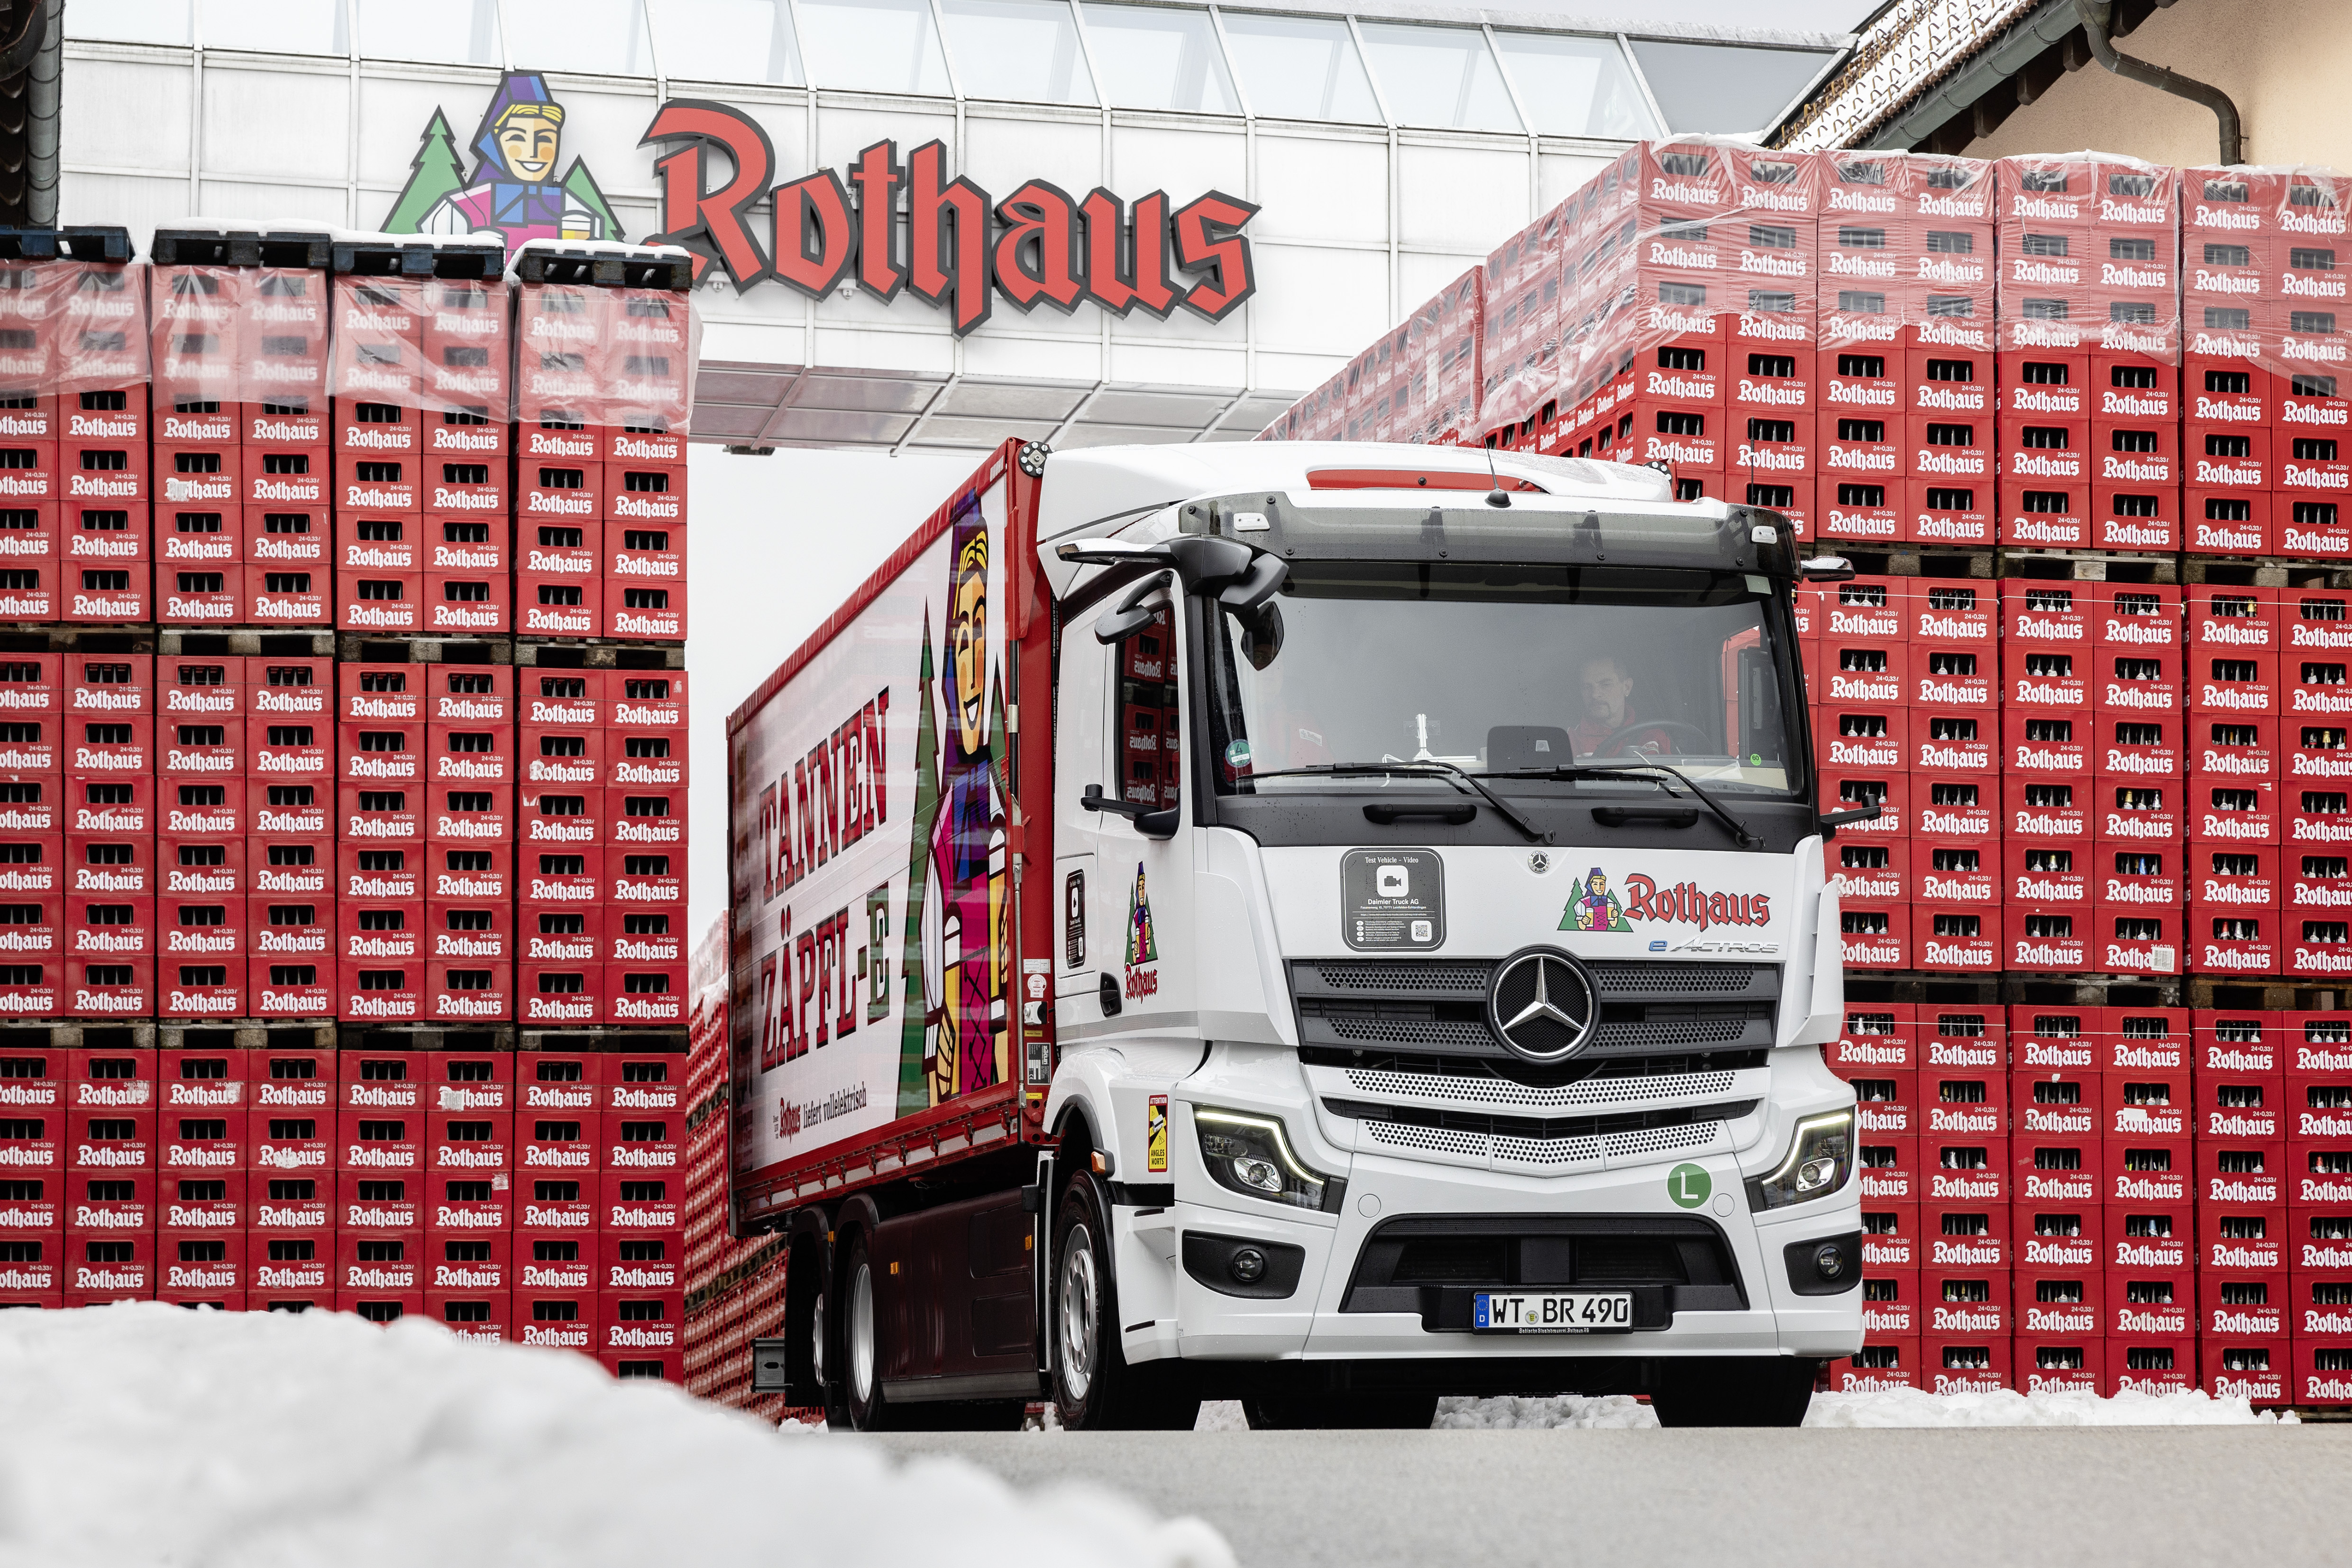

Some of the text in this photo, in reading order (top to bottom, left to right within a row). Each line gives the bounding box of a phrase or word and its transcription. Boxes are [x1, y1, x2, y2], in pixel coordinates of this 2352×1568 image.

[1650, 178, 1719, 205] Rothaus
[1828, 188, 1895, 212] Rothaus
[1917, 193, 1984, 219] Rothaus
[2195, 205, 2260, 230] Rothaus
[636, 98, 1262, 341] Rothaus
[1648, 242, 1718, 269] Rothaus
[2101, 264, 2166, 288] Rothaus
[2194, 270, 2260, 294] Rothaus
[2281, 273, 2346, 298] Rothaus
[531, 317, 595, 340] Rothaus
[616, 321, 678, 343] Rothaus
[2281, 337, 2346, 362] Rothaus
[1616, 382, 1634, 403] Rothaus
[1645, 372, 1715, 399] Rothaus
[1596, 394, 1614, 415] Rothaus
[1916, 385, 1984, 410] Rothaus
[2101, 391, 2168, 416] Rothaus
[1577, 406, 1594, 427] Rothaus
[2282, 400, 2348, 425] Rothaus
[163, 417, 231, 440] Rothaus
[345, 426, 412, 449] Rothaus
[1558, 417, 1576, 438] Rothaus
[529, 433, 594, 457] Rothaus
[1539, 430, 1556, 452] Rothaus
[1827, 445, 1895, 471] Rothaus
[2012, 452, 2080, 477] Rothaus
[2195, 460, 2261, 486] Rothaus
[2283, 464, 2349, 489] Rothaus
[252, 478, 320, 501] Rothaus
[432, 487, 499, 510] Rothaus
[613, 495, 679, 519] Rothaus
[1916, 514, 1985, 539] Rothaus
[2103, 521, 2169, 546] Rothaus
[165, 537, 233, 559] Rothaus
[2283, 528, 2349, 553] Rothaus
[345, 545, 412, 568] Rothaus
[527, 550, 593, 573] Rothaus
[72, 595, 140, 617] Rothaus
[254, 596, 321, 619] Rothaus
[433, 605, 499, 628] Rothaus
[1829, 611, 1898, 636] Rothaus
[1918, 614, 1987, 639] Rothaus
[2104, 619, 2172, 645] Rothaus
[73, 688, 141, 710] Rothaus
[1829, 676, 1899, 701] Rothaus
[2015, 680, 2084, 705] Rothaus
[2201, 685, 2269, 710] Rothaus
[256, 690, 323, 713] Rothaus
[437, 697, 503, 720] Rothaus
[614, 703, 679, 725] Rothaus
[74, 748, 143, 770] Rothaus
[1235, 743, 1243, 753] 4
[1919, 744, 1988, 769] Rothaus
[166, 750, 234, 772] Rothaus
[348, 756, 415, 779] Rothaus
[615, 762, 680, 784] Rothaus
[759, 686, 889, 905] TANNEN
[167, 810, 235, 833] Rothaus
[436, 816, 503, 839] Rothaus
[614, 821, 680, 843] Rothaus
[2014, 811, 2083, 836] Rothaus
[2202, 815, 2270, 839] Rothaus
[167, 871, 235, 893] Rothaus
[348, 875, 415, 898] Rothaus
[2015, 876, 2084, 901] Rothaus
[2105, 879, 2173, 904] Rothaus
[2203, 880, 2270, 905] Rothaus
[1623, 872, 1771, 932] Rothaus
[167, 931, 236, 953] Rothaus
[258, 930, 326, 953] Rothaus
[348, 935, 415, 957] Rothaus
[613, 939, 678, 961] Rothaus
[2014, 941, 2083, 966] Rothaus
[761, 880, 890, 1074] ZÄPFL-E
[1125, 963, 1158, 1004] Rothaus
[74, 990, 143, 1012] Rothaus
[260, 990, 327, 1012] Rothaus
[349, 995, 416, 1017] Rothaus
[614, 997, 679, 1019] Rothaus
[2024, 1042, 2092, 1067] Rothaus
[2206, 1046, 2273, 1072] Rothaus
[349, 1084, 416, 1107] Rothaus
[611, 1087, 677, 1109] Rothaus
[803, 1098, 822, 1129] liefert
[823, 1081, 867, 1122] vollelektrisch
[2208, 1112, 2275, 1137] Rothaus
[167, 1145, 236, 1167] Rothaus
[524, 1145, 590, 1167] Rothaus
[611, 1146, 676, 1168] Rothaus
[1681, 1172, 1698, 1199] L
[2024, 1175, 2092, 1200] Rothaus
[2209, 1178, 2277, 1203] Rothaus
[74, 1206, 144, 1229] Rothaus
[257, 1205, 325, 1228] Rothaus
[347, 1205, 414, 1228] Rothaus
[610, 1206, 676, 1228] Rothaus
[1931, 1241, 2000, 1265] Rothaus
[2211, 1244, 2278, 1268] Rothaus
[75, 1267, 144, 1290] Rothaus
[346, 1266, 413, 1288] Rothaus
[522, 1265, 588, 1288] Rothaus
[1492, 1298, 1628, 1323] WT BR 490
[2026, 1308, 2094, 1332] Rothaus
[608, 1326, 674, 1348] Rothaus
